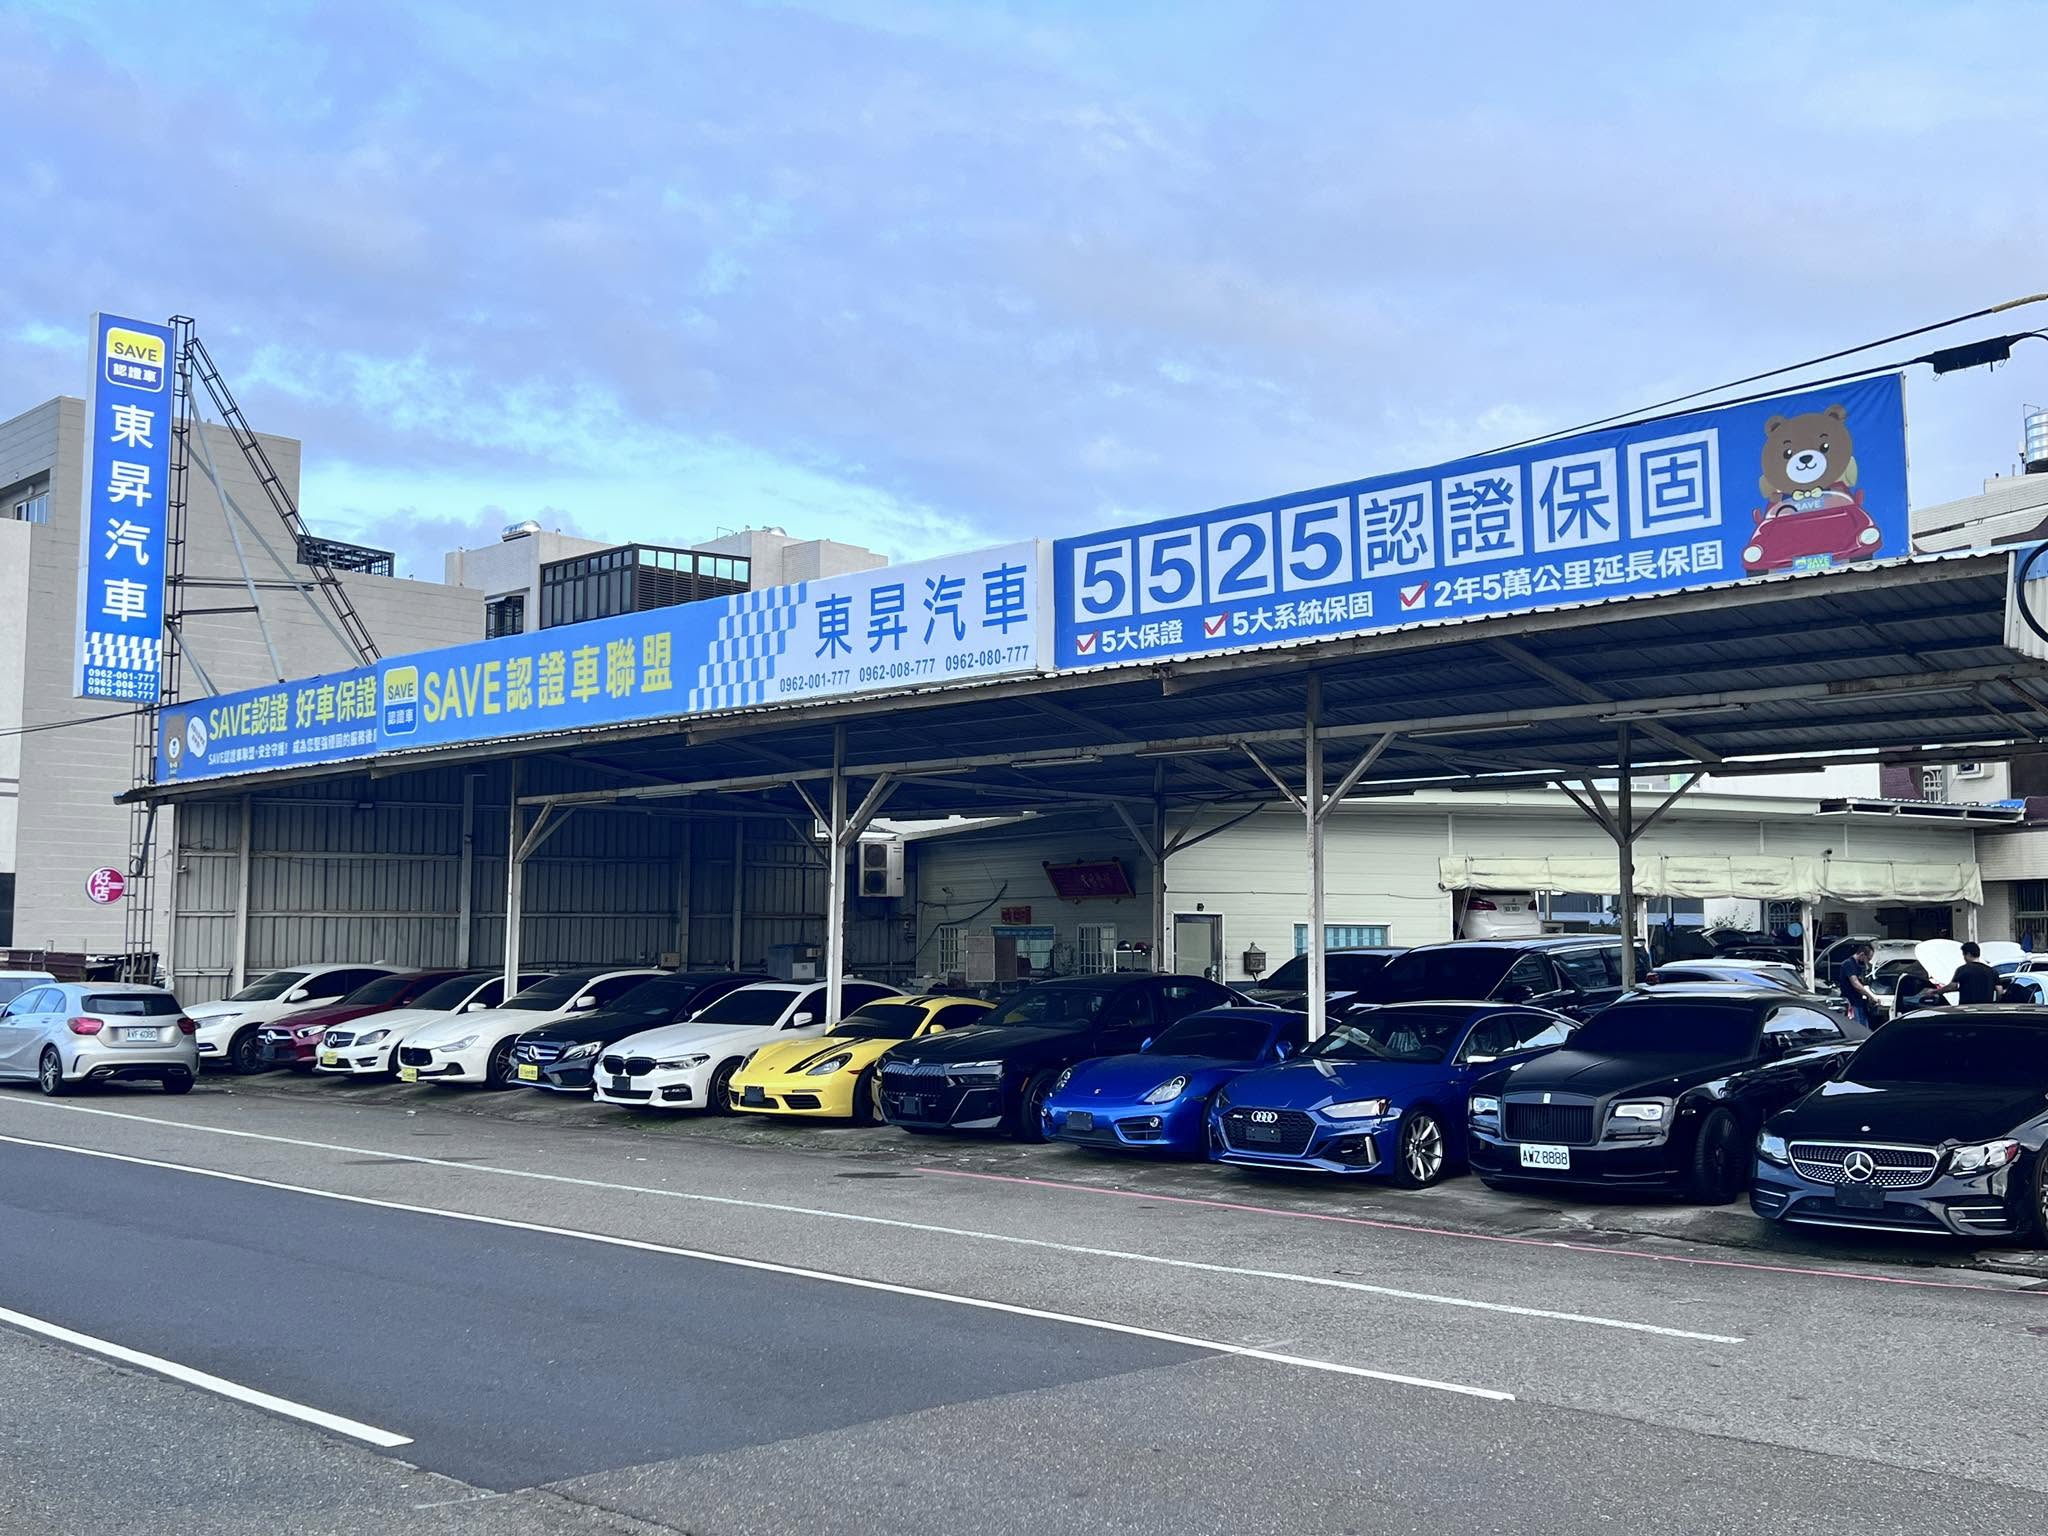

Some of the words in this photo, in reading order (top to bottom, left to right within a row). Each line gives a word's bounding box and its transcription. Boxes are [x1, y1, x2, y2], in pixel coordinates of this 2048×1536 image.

[113, 341, 158, 362] SAVE
[112, 362, 157, 383] 認證車
[102, 404, 156, 623] 東昇汽車
[1433, 539, 1723, 608] 2年5萬公里延長保固
[815, 562, 1028, 660] 東昇汽車
[1232, 590, 1374, 634] 5大系統保固
[1101, 618, 1184, 653] 5大保證
[88, 668, 156, 682] 0962-001-777
[88, 677, 155, 691] 0962-008-777
[423, 632, 673, 723] SAVE認證車聯盟
[780, 669, 851, 693] 0962-001-777
[859, 658, 936, 683] 0962-008-777
[945, 645, 1030, 672] 0962-080-777
[87, 686, 155, 700] 0962-080-777
[209, 692, 289, 741] SAVE認證
[295, 675, 377, 729] 好車保證
[388, 682, 414, 701] SAVE
[95, 870, 111, 901] 好店
